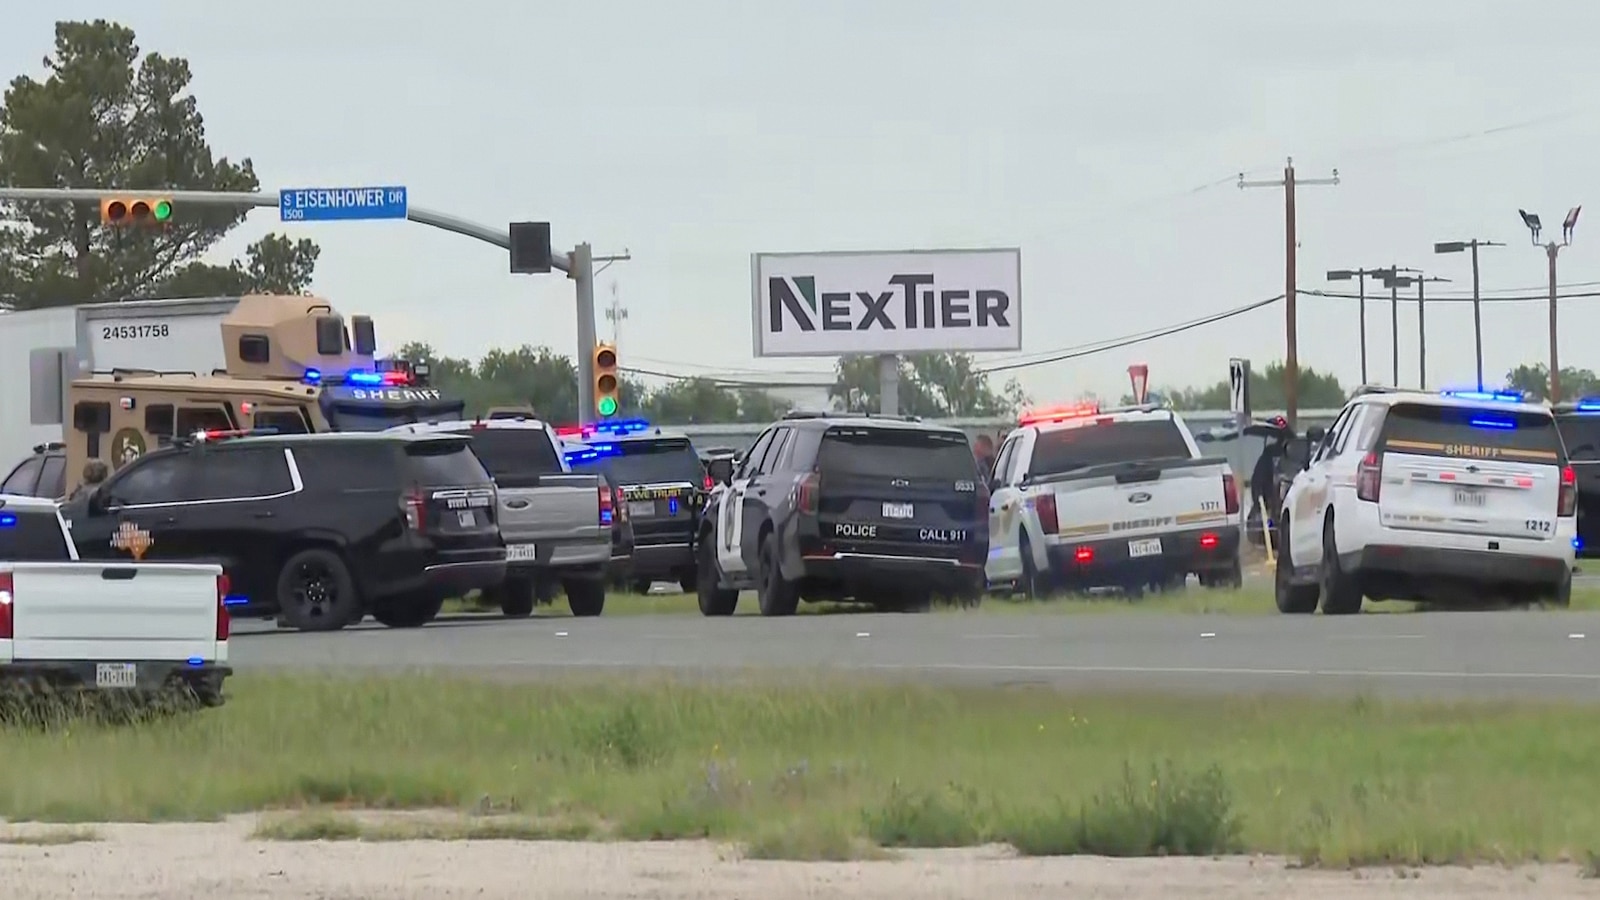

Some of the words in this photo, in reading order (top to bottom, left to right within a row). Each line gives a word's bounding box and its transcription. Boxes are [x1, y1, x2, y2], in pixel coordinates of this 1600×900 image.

[284, 194, 291, 206] S
[296, 189, 384, 208] EISENHOWER
[388, 191, 403, 204] DR
[283, 209, 304, 220] 1500
[103, 324, 169, 339] 24531758
[352, 388, 441, 401] SHERIFF
[1446, 444, 1499, 457] SHERIFF
[835, 523, 876, 537] POLICE
[1524, 519, 1551, 532] 1212
[919, 528, 948, 541] CALL
[949, 529, 967, 541] 911
